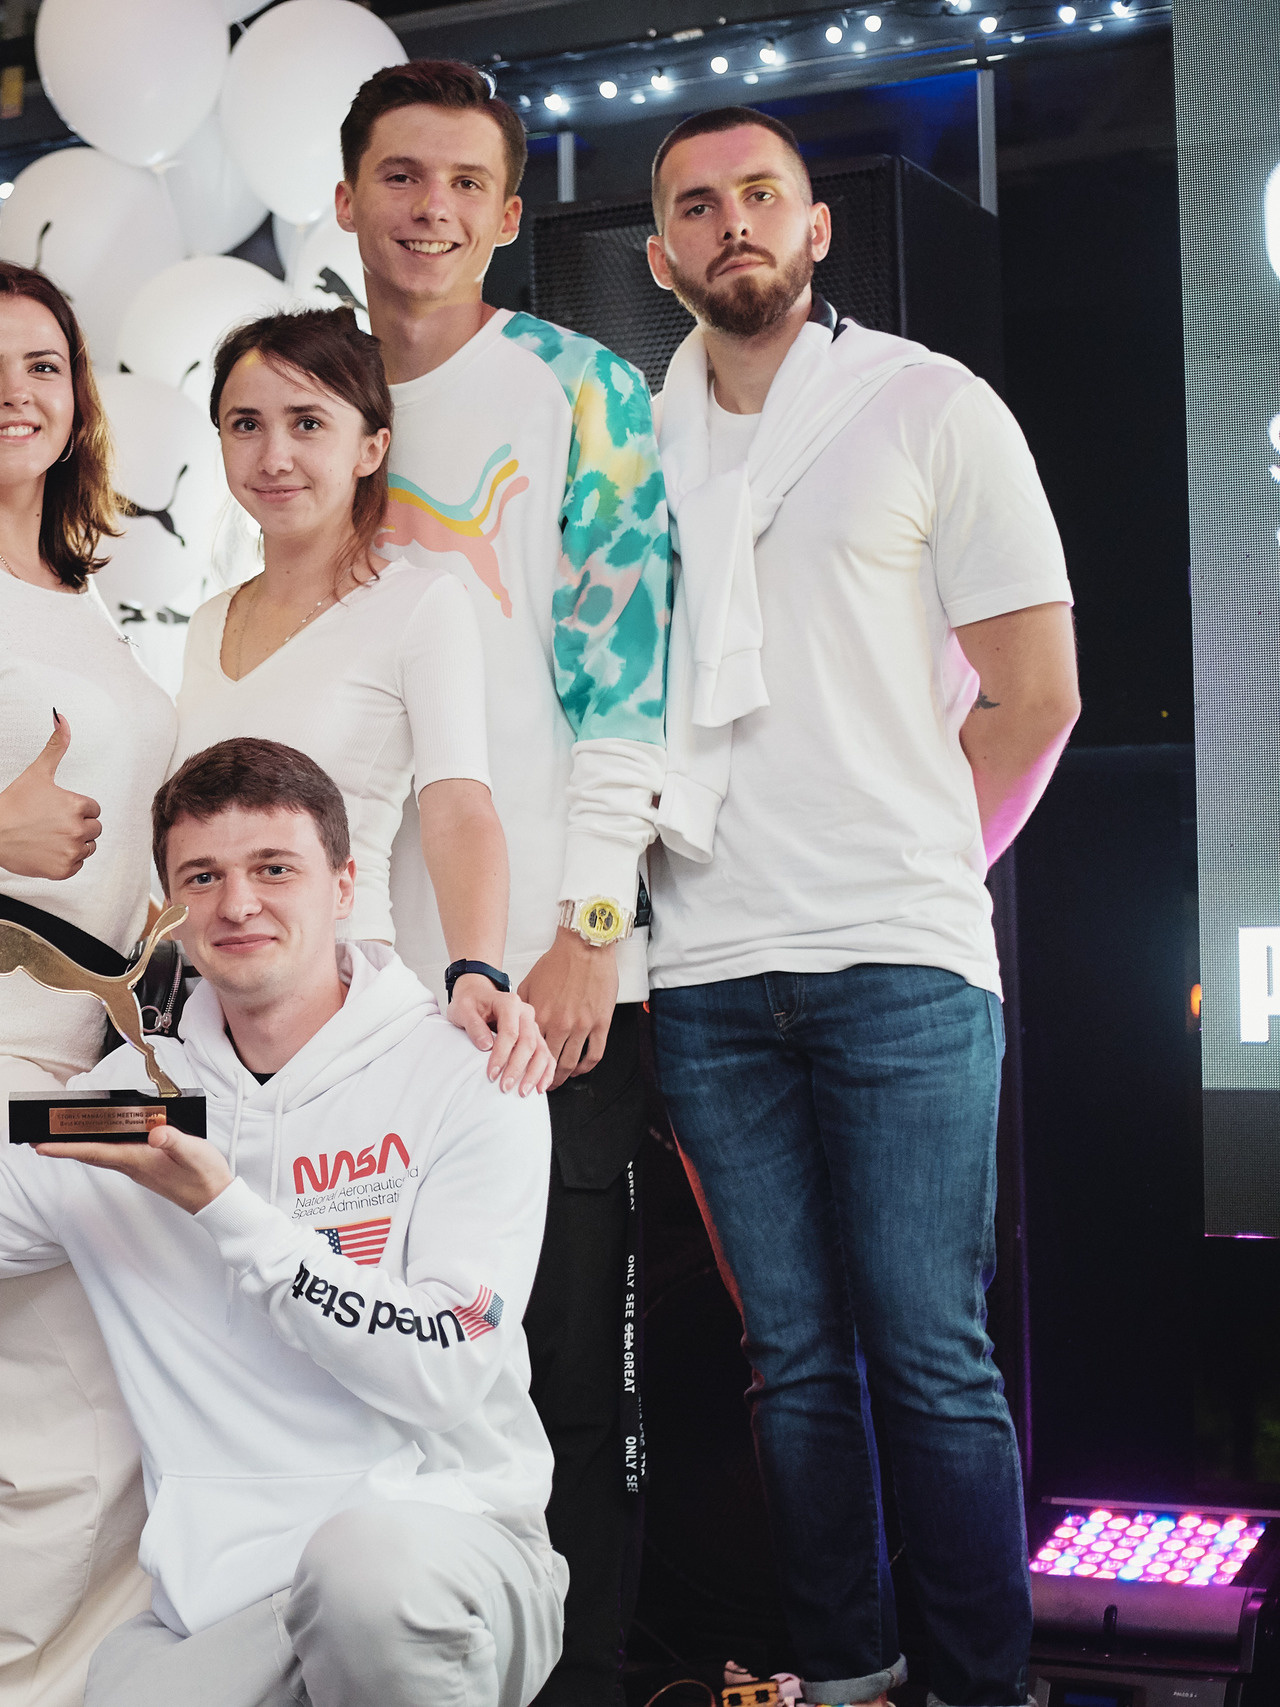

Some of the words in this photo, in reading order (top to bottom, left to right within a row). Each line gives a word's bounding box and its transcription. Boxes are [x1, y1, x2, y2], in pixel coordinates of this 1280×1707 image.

[293, 1132, 410, 1194] NASA
[291, 1205, 326, 1219] Space
[328, 1190, 400, 1212] Administrati
[295, 1189, 338, 1208] National
[627, 1170, 635, 1212] GREAT
[626, 1254, 635, 1288] ONLY
[625, 1293, 635, 1318] SEE
[623, 1351, 636, 1394] GREAT
[625, 1435, 637, 1470] ONLY
